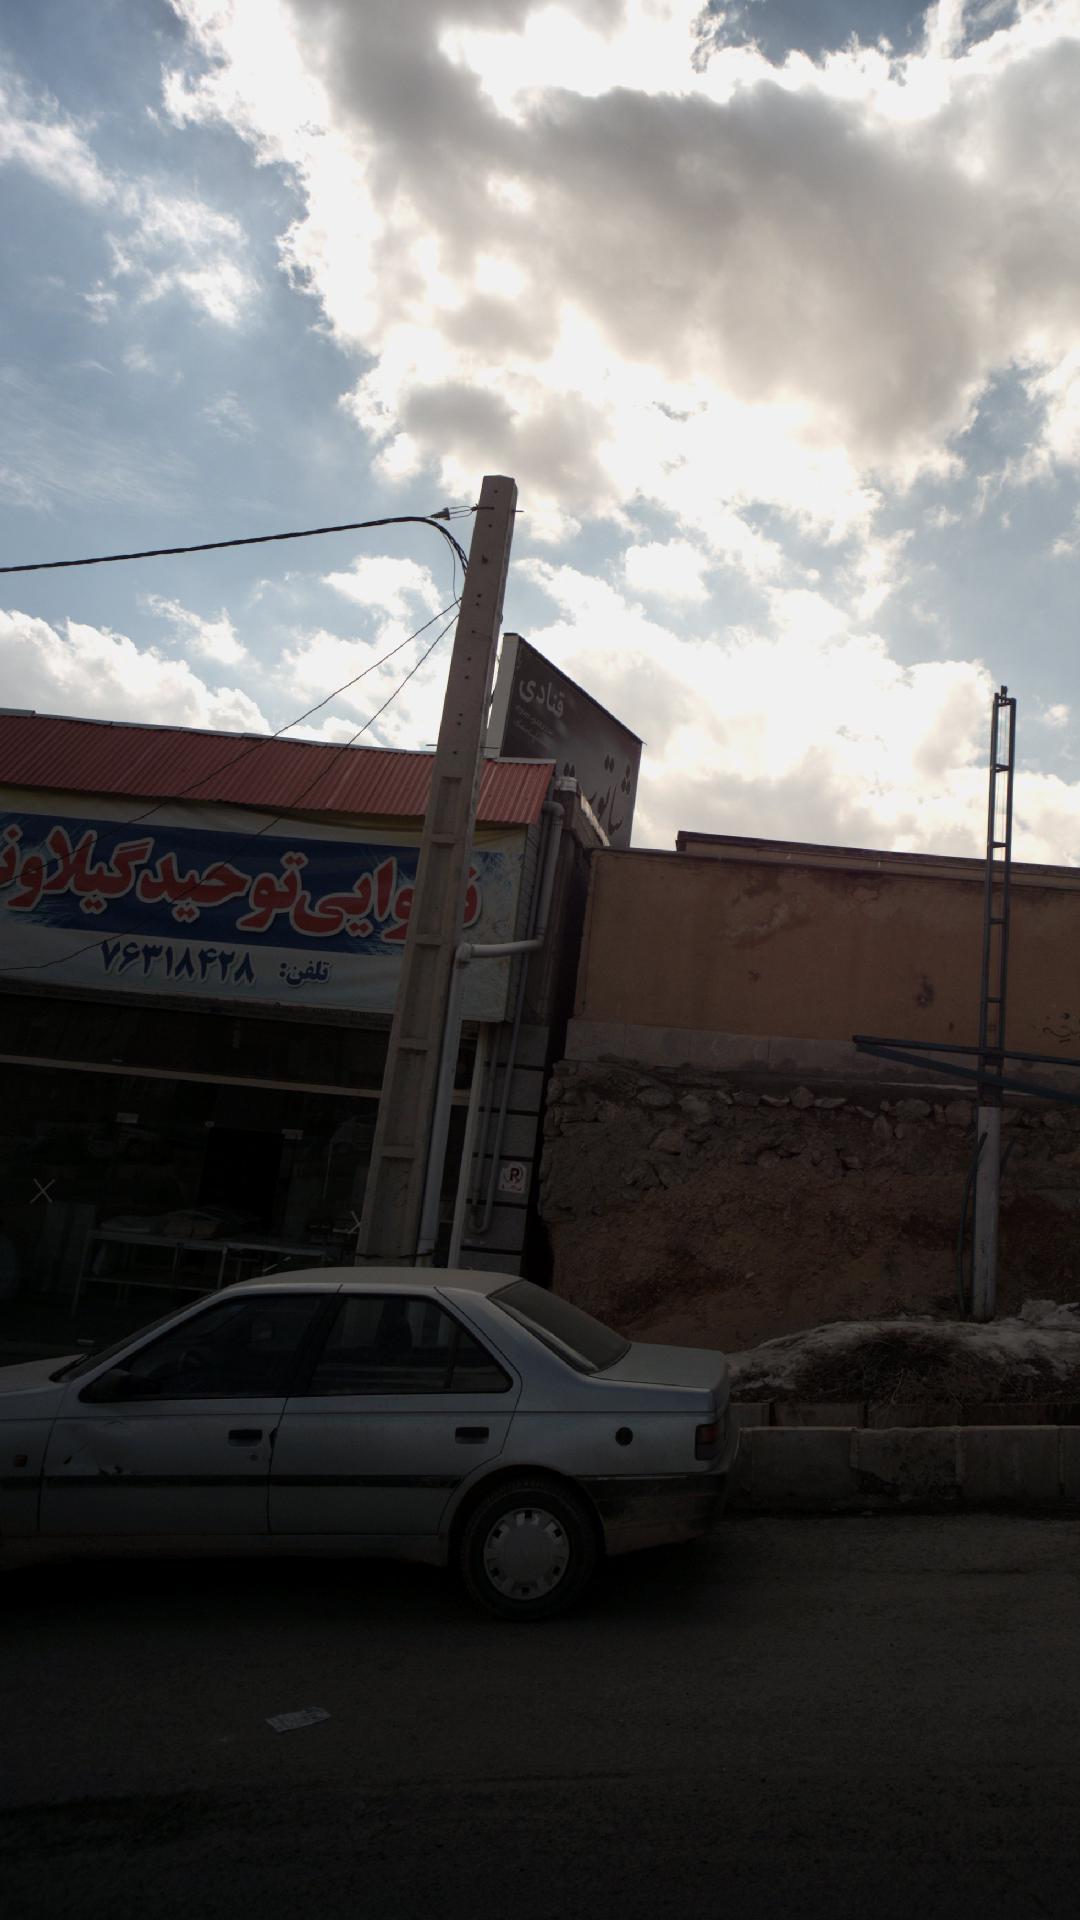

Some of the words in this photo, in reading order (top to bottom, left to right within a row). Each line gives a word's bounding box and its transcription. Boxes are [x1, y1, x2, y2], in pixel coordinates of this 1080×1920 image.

[519, 679, 565, 718] قنادی
[0, 824, 155, 915] گیلاون
[136, 851, 308, 932] توحید
[101, 940, 254, 984] ۷۶۳۱۸۴۲۸
[280, 960, 331, 984] تلفن:
